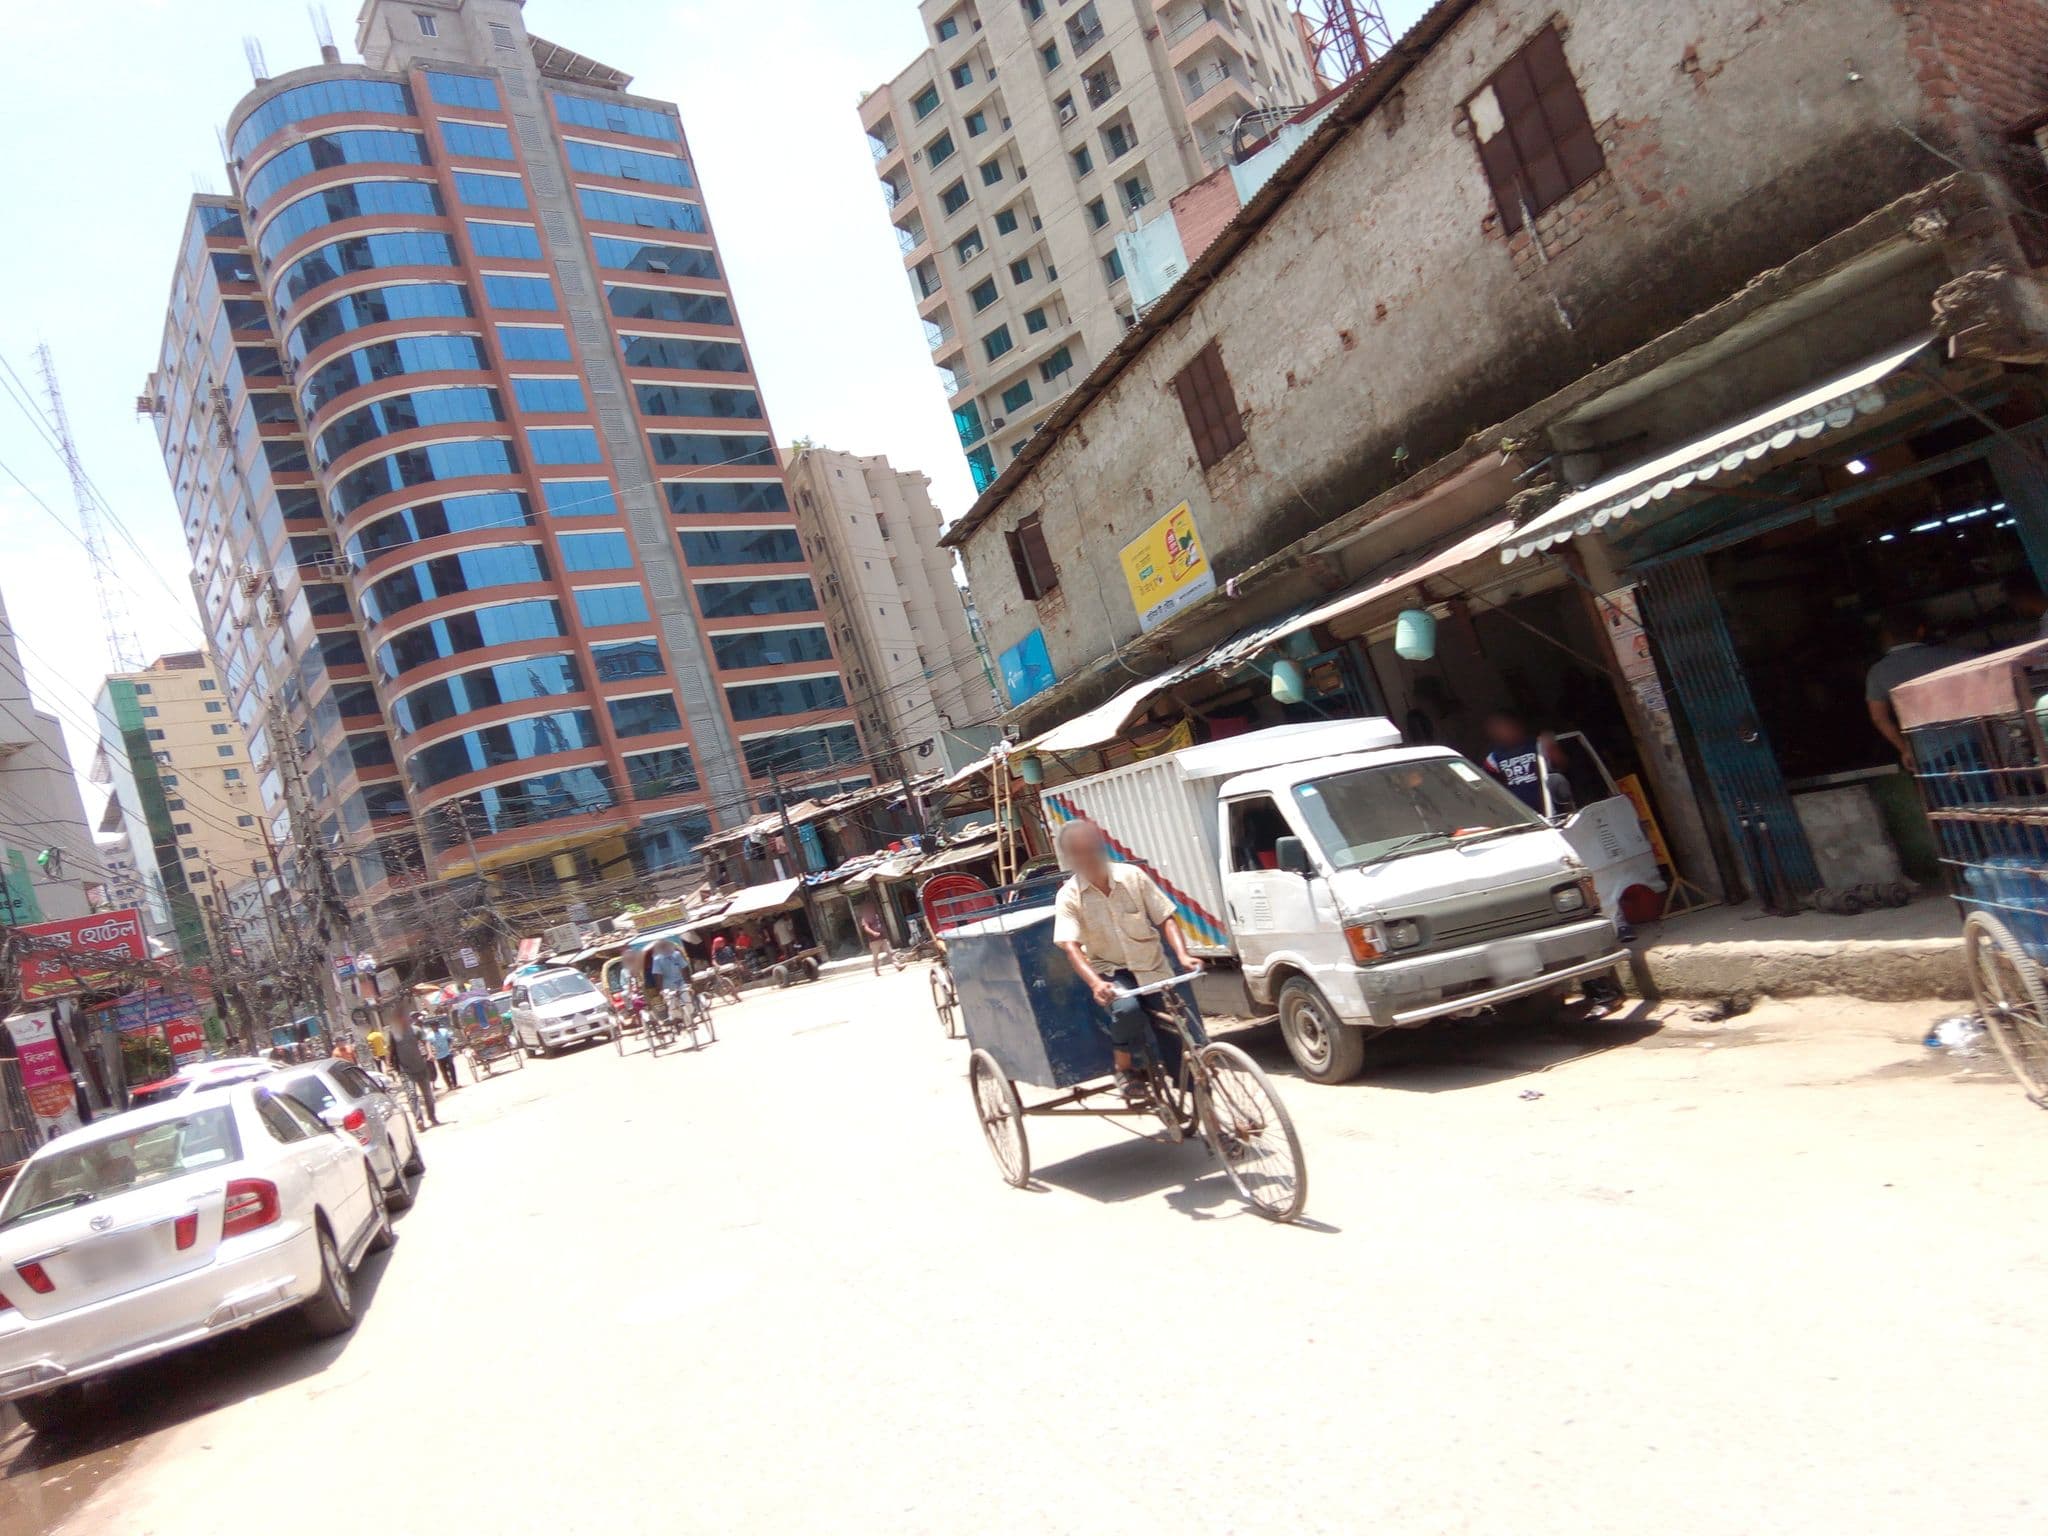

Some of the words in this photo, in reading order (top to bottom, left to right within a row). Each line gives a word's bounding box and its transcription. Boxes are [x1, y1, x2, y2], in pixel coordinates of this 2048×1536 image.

[1499, 753, 1536, 770] SUPER
[1505, 762, 1530, 778] DRY
[77, 919, 137, 944] হোটেল
[172, 1031, 197, 1045] ATM
